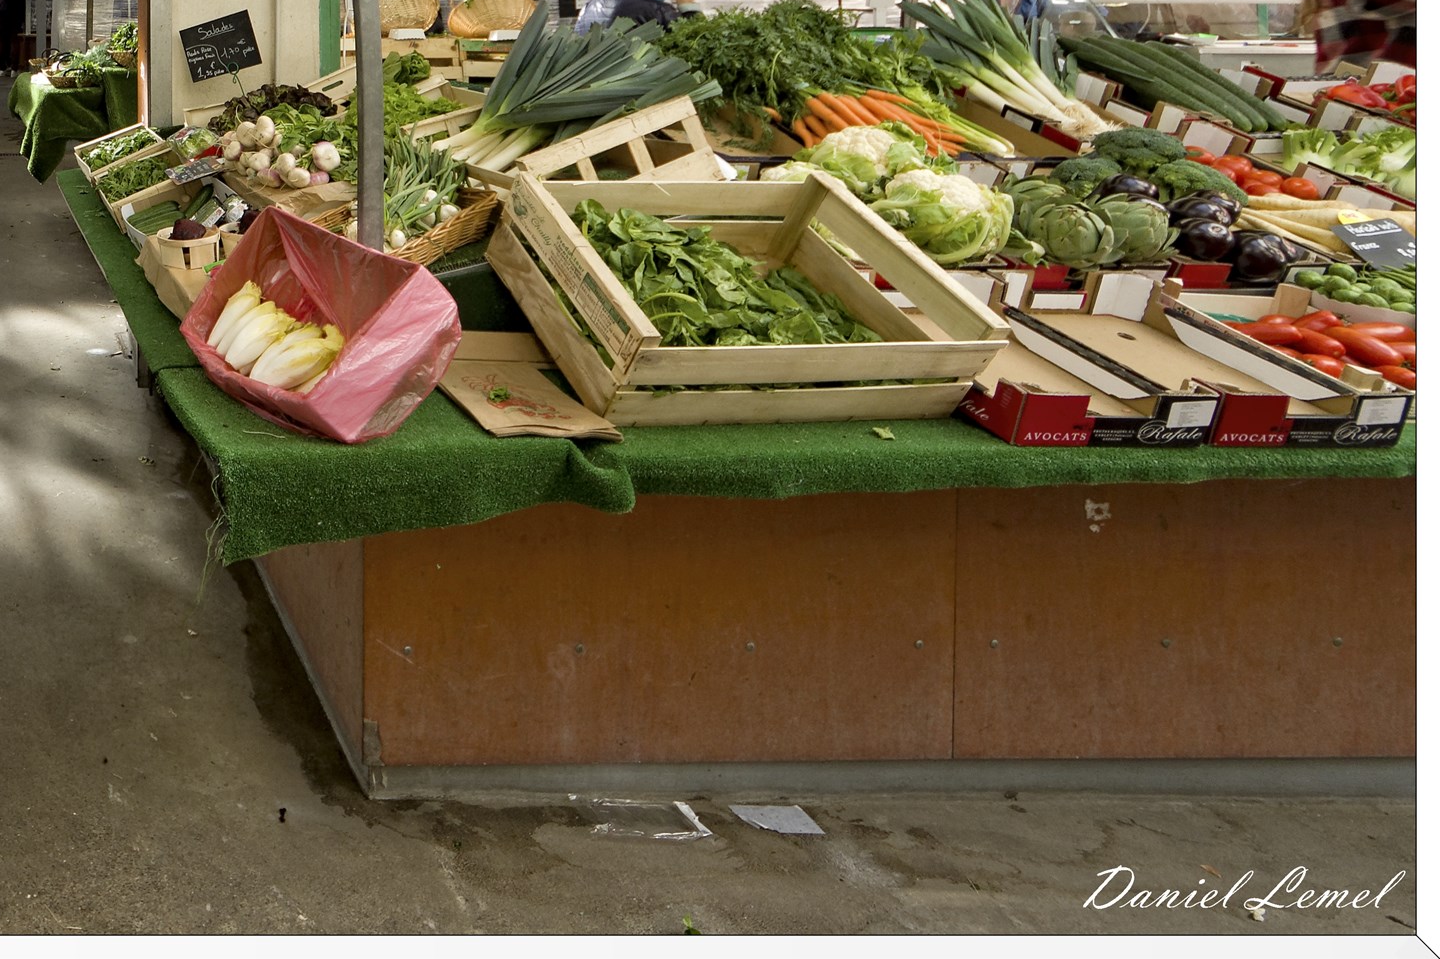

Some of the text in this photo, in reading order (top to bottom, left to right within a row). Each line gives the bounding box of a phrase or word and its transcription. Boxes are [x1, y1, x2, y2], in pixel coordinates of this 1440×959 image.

[197, 21, 235, 40] Salades
[1023, 431, 1088, 442] AVOCATS
[1138, 419, 1203, 445] Rafale
[1219, 432, 1285, 443] AVOCATS
[1332, 420, 1399, 446] Rafale
